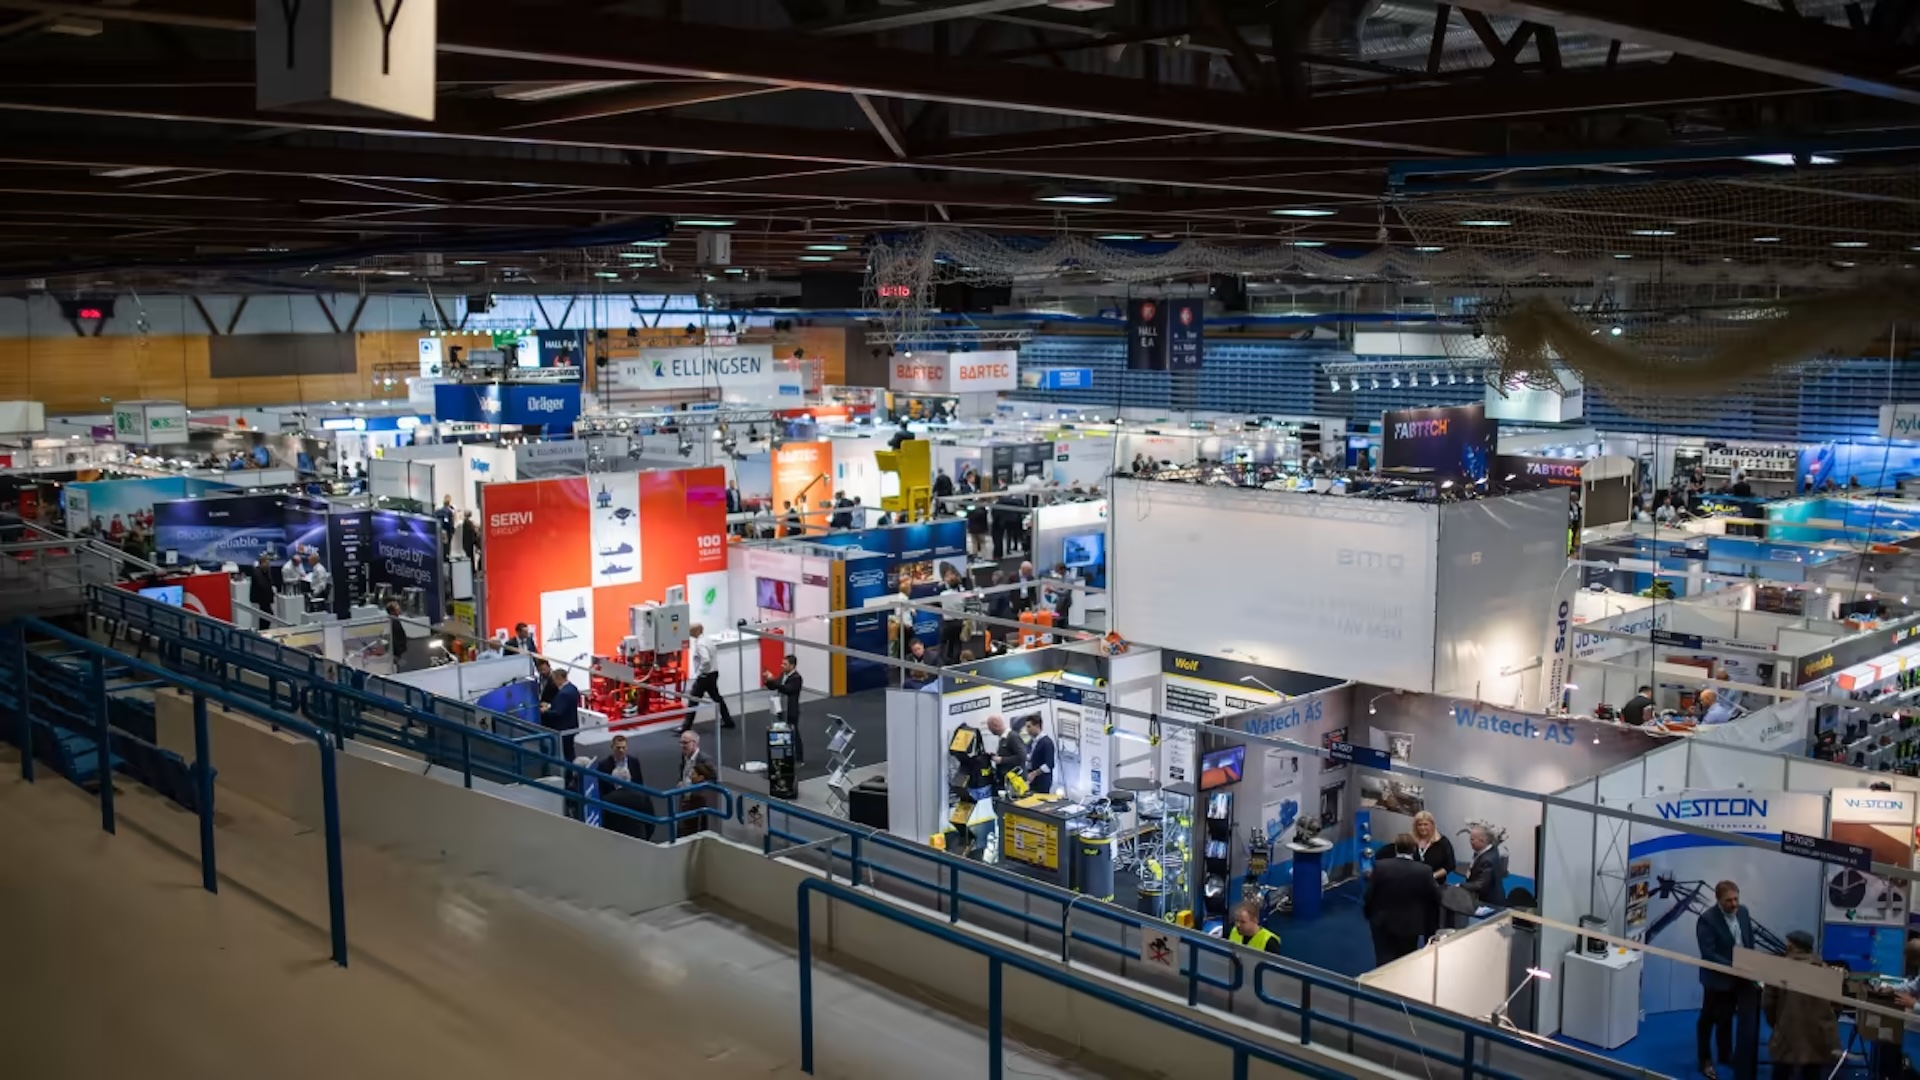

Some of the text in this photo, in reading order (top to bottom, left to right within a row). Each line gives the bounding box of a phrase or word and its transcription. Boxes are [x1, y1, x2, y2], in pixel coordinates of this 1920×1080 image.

[672, 356, 761, 377] ELLINGSEN
[896, 364, 943, 380] BARTEC
[960, 364, 1009, 380] BARTEC
[528, 397, 564, 412] Dräger
[1394, 419, 1448, 439] FABTECH
[1895, 413, 1920, 434] xyl
[1709, 444, 1796, 459] Panasonic
[490, 512, 533, 527] SERVI
[215, 536, 259, 549] reliable
[697, 535, 721, 548] 100
[379, 541, 424, 567] Inspired by
[1555, 601, 1569, 653] OPS
[1175, 657, 1199, 671] Wolf
[1244, 708, 1300, 735] Watech
[1455, 706, 1576, 745] Watech AS
[1656, 798, 1767, 819] WESTCON
[1845, 799, 1903, 810] WESTCON
